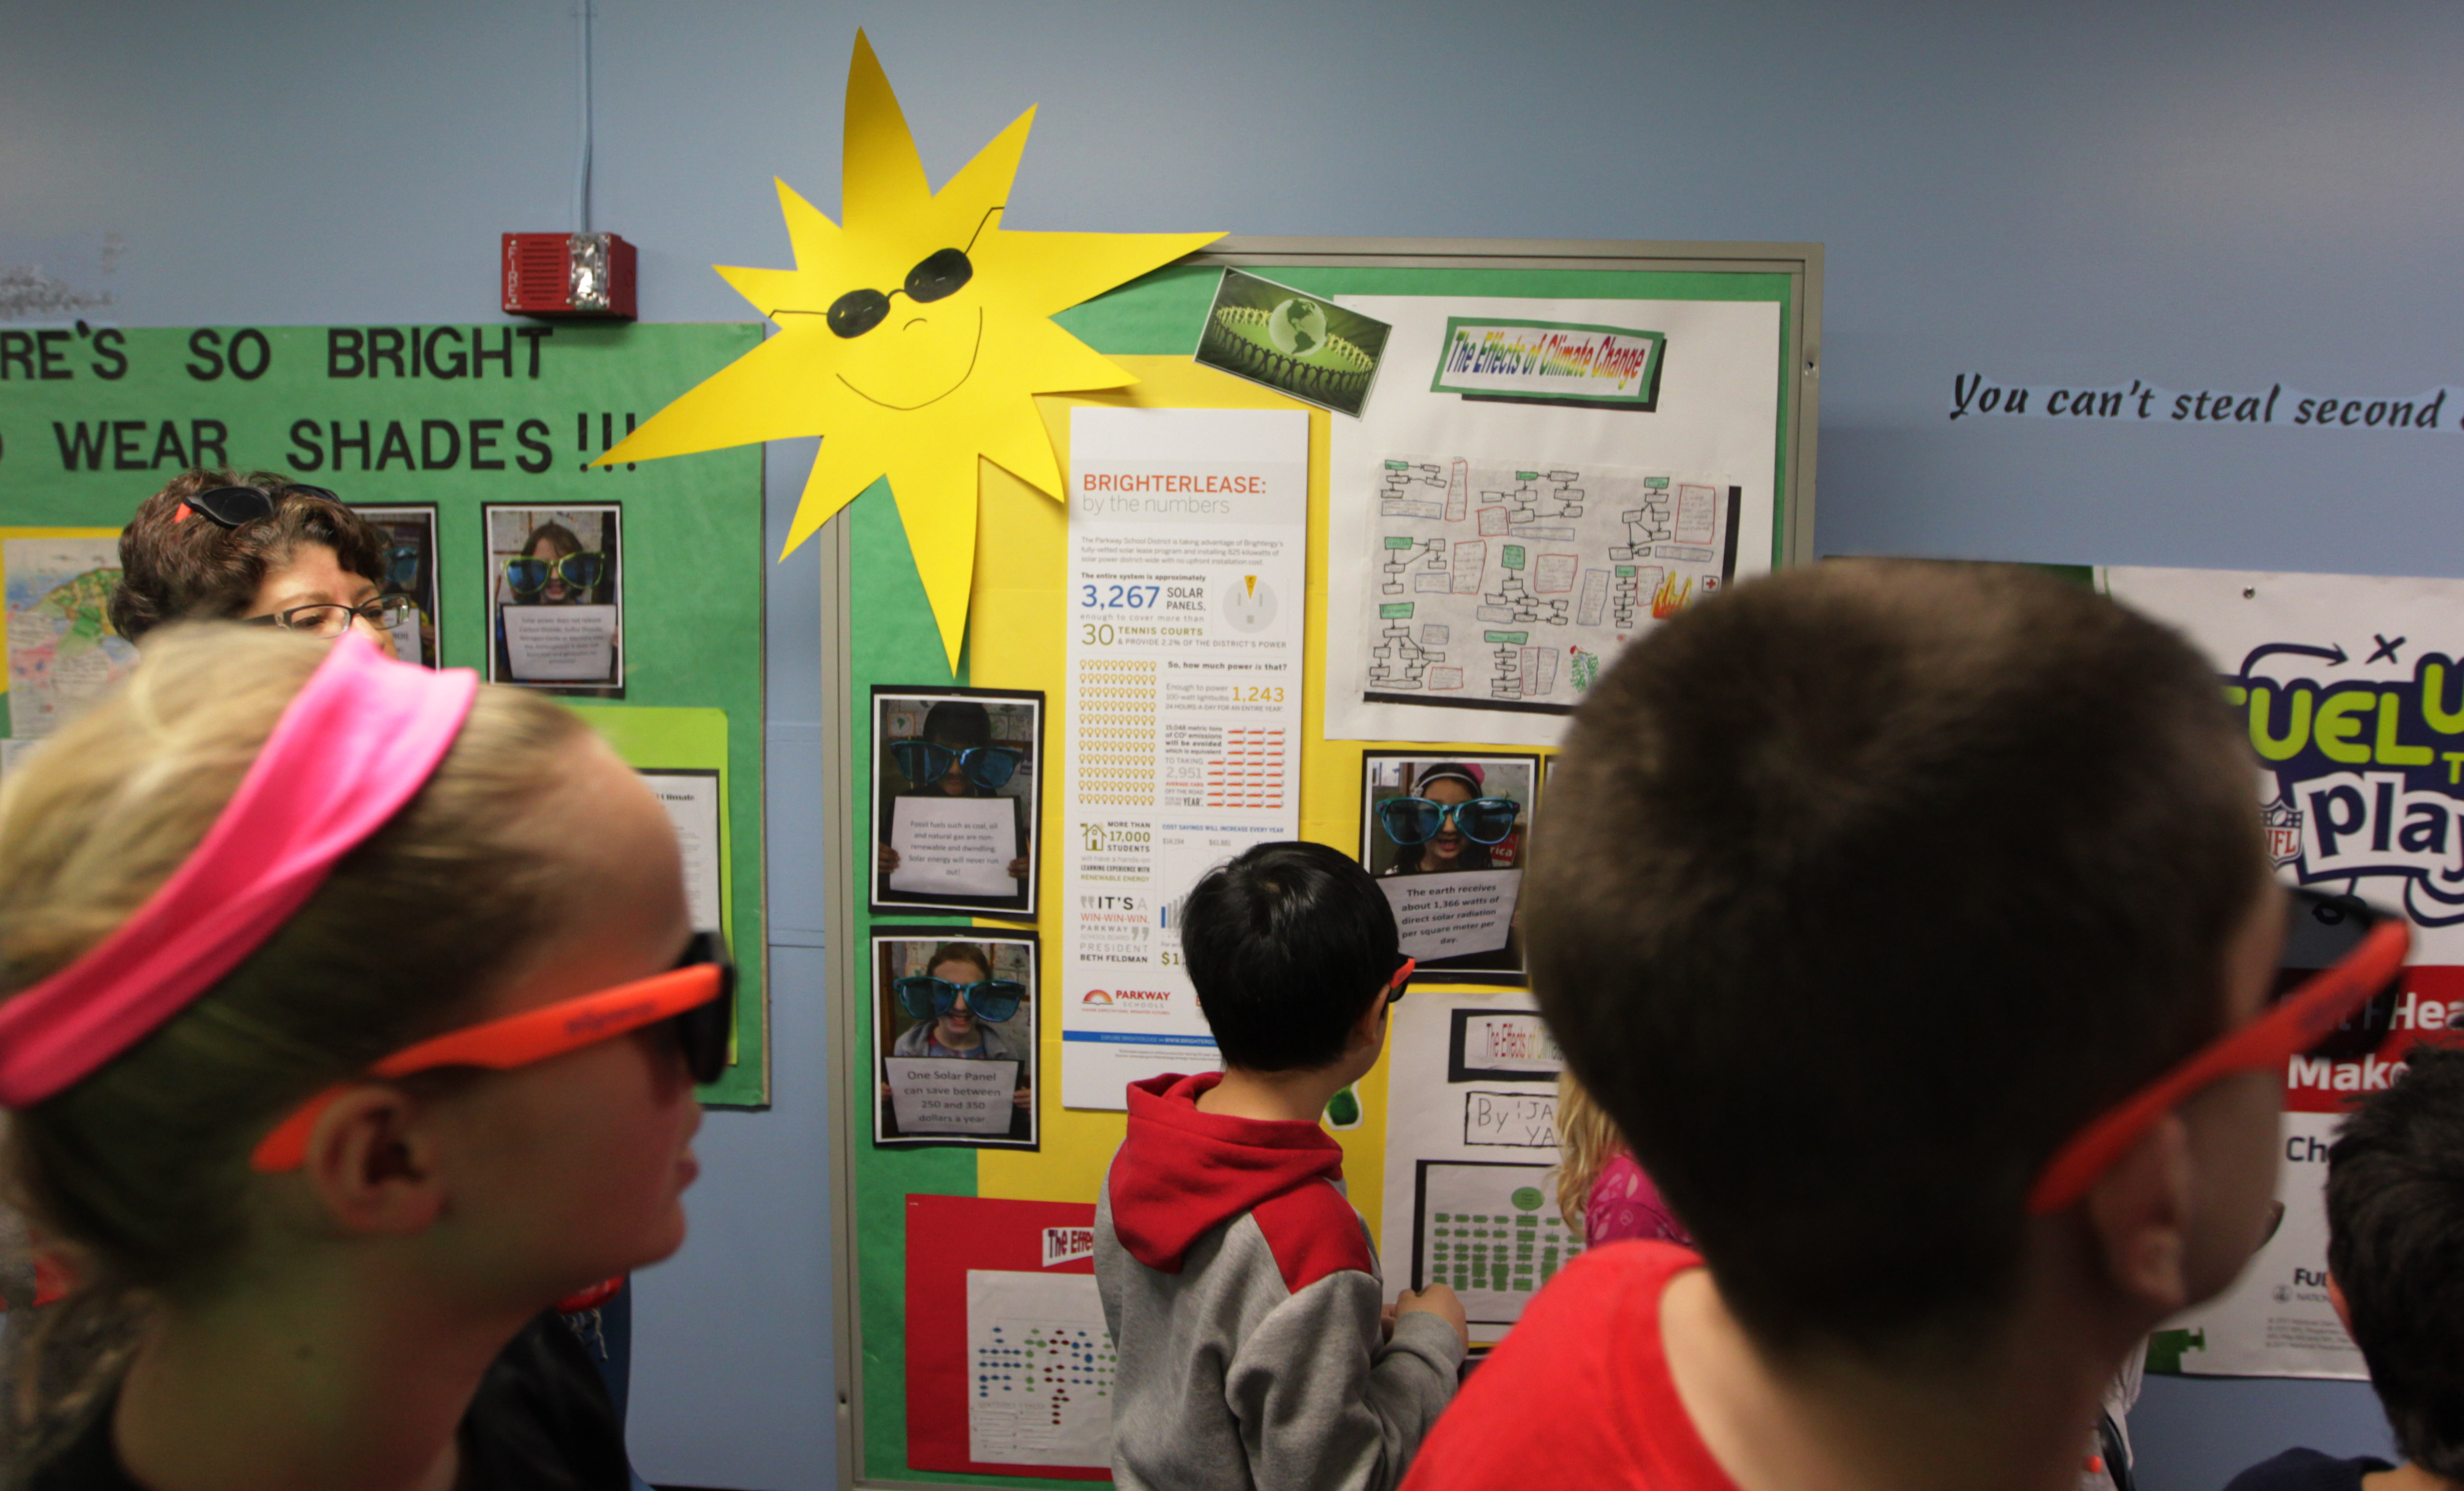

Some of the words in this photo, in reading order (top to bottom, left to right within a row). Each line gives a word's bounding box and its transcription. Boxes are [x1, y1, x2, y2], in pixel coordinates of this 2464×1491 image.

[508, 246, 519, 298] FIRE
[0, 320, 128, 381] RE'S
[186, 327, 271, 381] SO
[327, 326, 553, 380] BRIGHT
[1447, 331, 1475, 373] The
[1472, 331, 1525, 375] Effects
[1522, 333, 1548, 375] of
[1539, 334, 1593, 378] Climate
[1591, 335, 1645, 390] Change
[1949, 372, 2029, 421] You
[2046, 379, 2156, 418] can't
[2171, 383, 2281, 423] steal
[2294, 387, 2448, 429] second
[53, 419, 227, 471] WEAR
[286, 418, 552, 473] SHADES
[1084, 474, 1266, 494] BRIGHTERLEASE:
[1083, 495, 1104, 516] by
[1110, 495, 1140, 512] the
[1145, 495, 1230, 514] numbers
[1082, 584, 1160, 610] 3,267
[1167, 587, 1203, 599] SOLAR
[1166, 600, 1206, 611] PANELS,
[1080, 613, 1113, 623] enough
[1082, 624, 1114, 645] 30
[1119, 626, 1157, 635] TENNIS
[1160, 627, 1203, 636] COURTS
[1166, 683, 1194, 692] Enough
[1233, 686, 1284, 703] 1,243
[1110, 831, 1150, 843] 17,000
[1429, 886, 1455, 895] earth
[1137, 898, 1148, 910] A
[1402, 902, 1430, 911] about
[1434, 900, 1459, 909] 1,366
[1462, 898, 1487, 906] watts
[1402, 916, 1430, 925] direct
[1432, 913, 1455, 921] solar
[1457, 909, 1496, 919] radiation
[1420, 926, 1451, 936] square
[1453, 922, 1478, 931] meter
[1080, 943, 1149, 953] PRESIDENT
[1116, 990, 1171, 1001] PARKWAY
[1486, 1023, 1499, 1057] The
[1501, 1023, 1526, 1059] Effects
[1528, 1025, 1537, 1059] of
[907, 1071, 930, 1080] One
[934, 1071, 962, 1080] Solar
[964, 1072, 997, 1081] Panel
[953, 1087, 1001, 1096] between
[921, 1100, 941, 1108] 250
[918, 1114, 953, 1122] dollars
[1048, 1229, 1067, 1258] The
